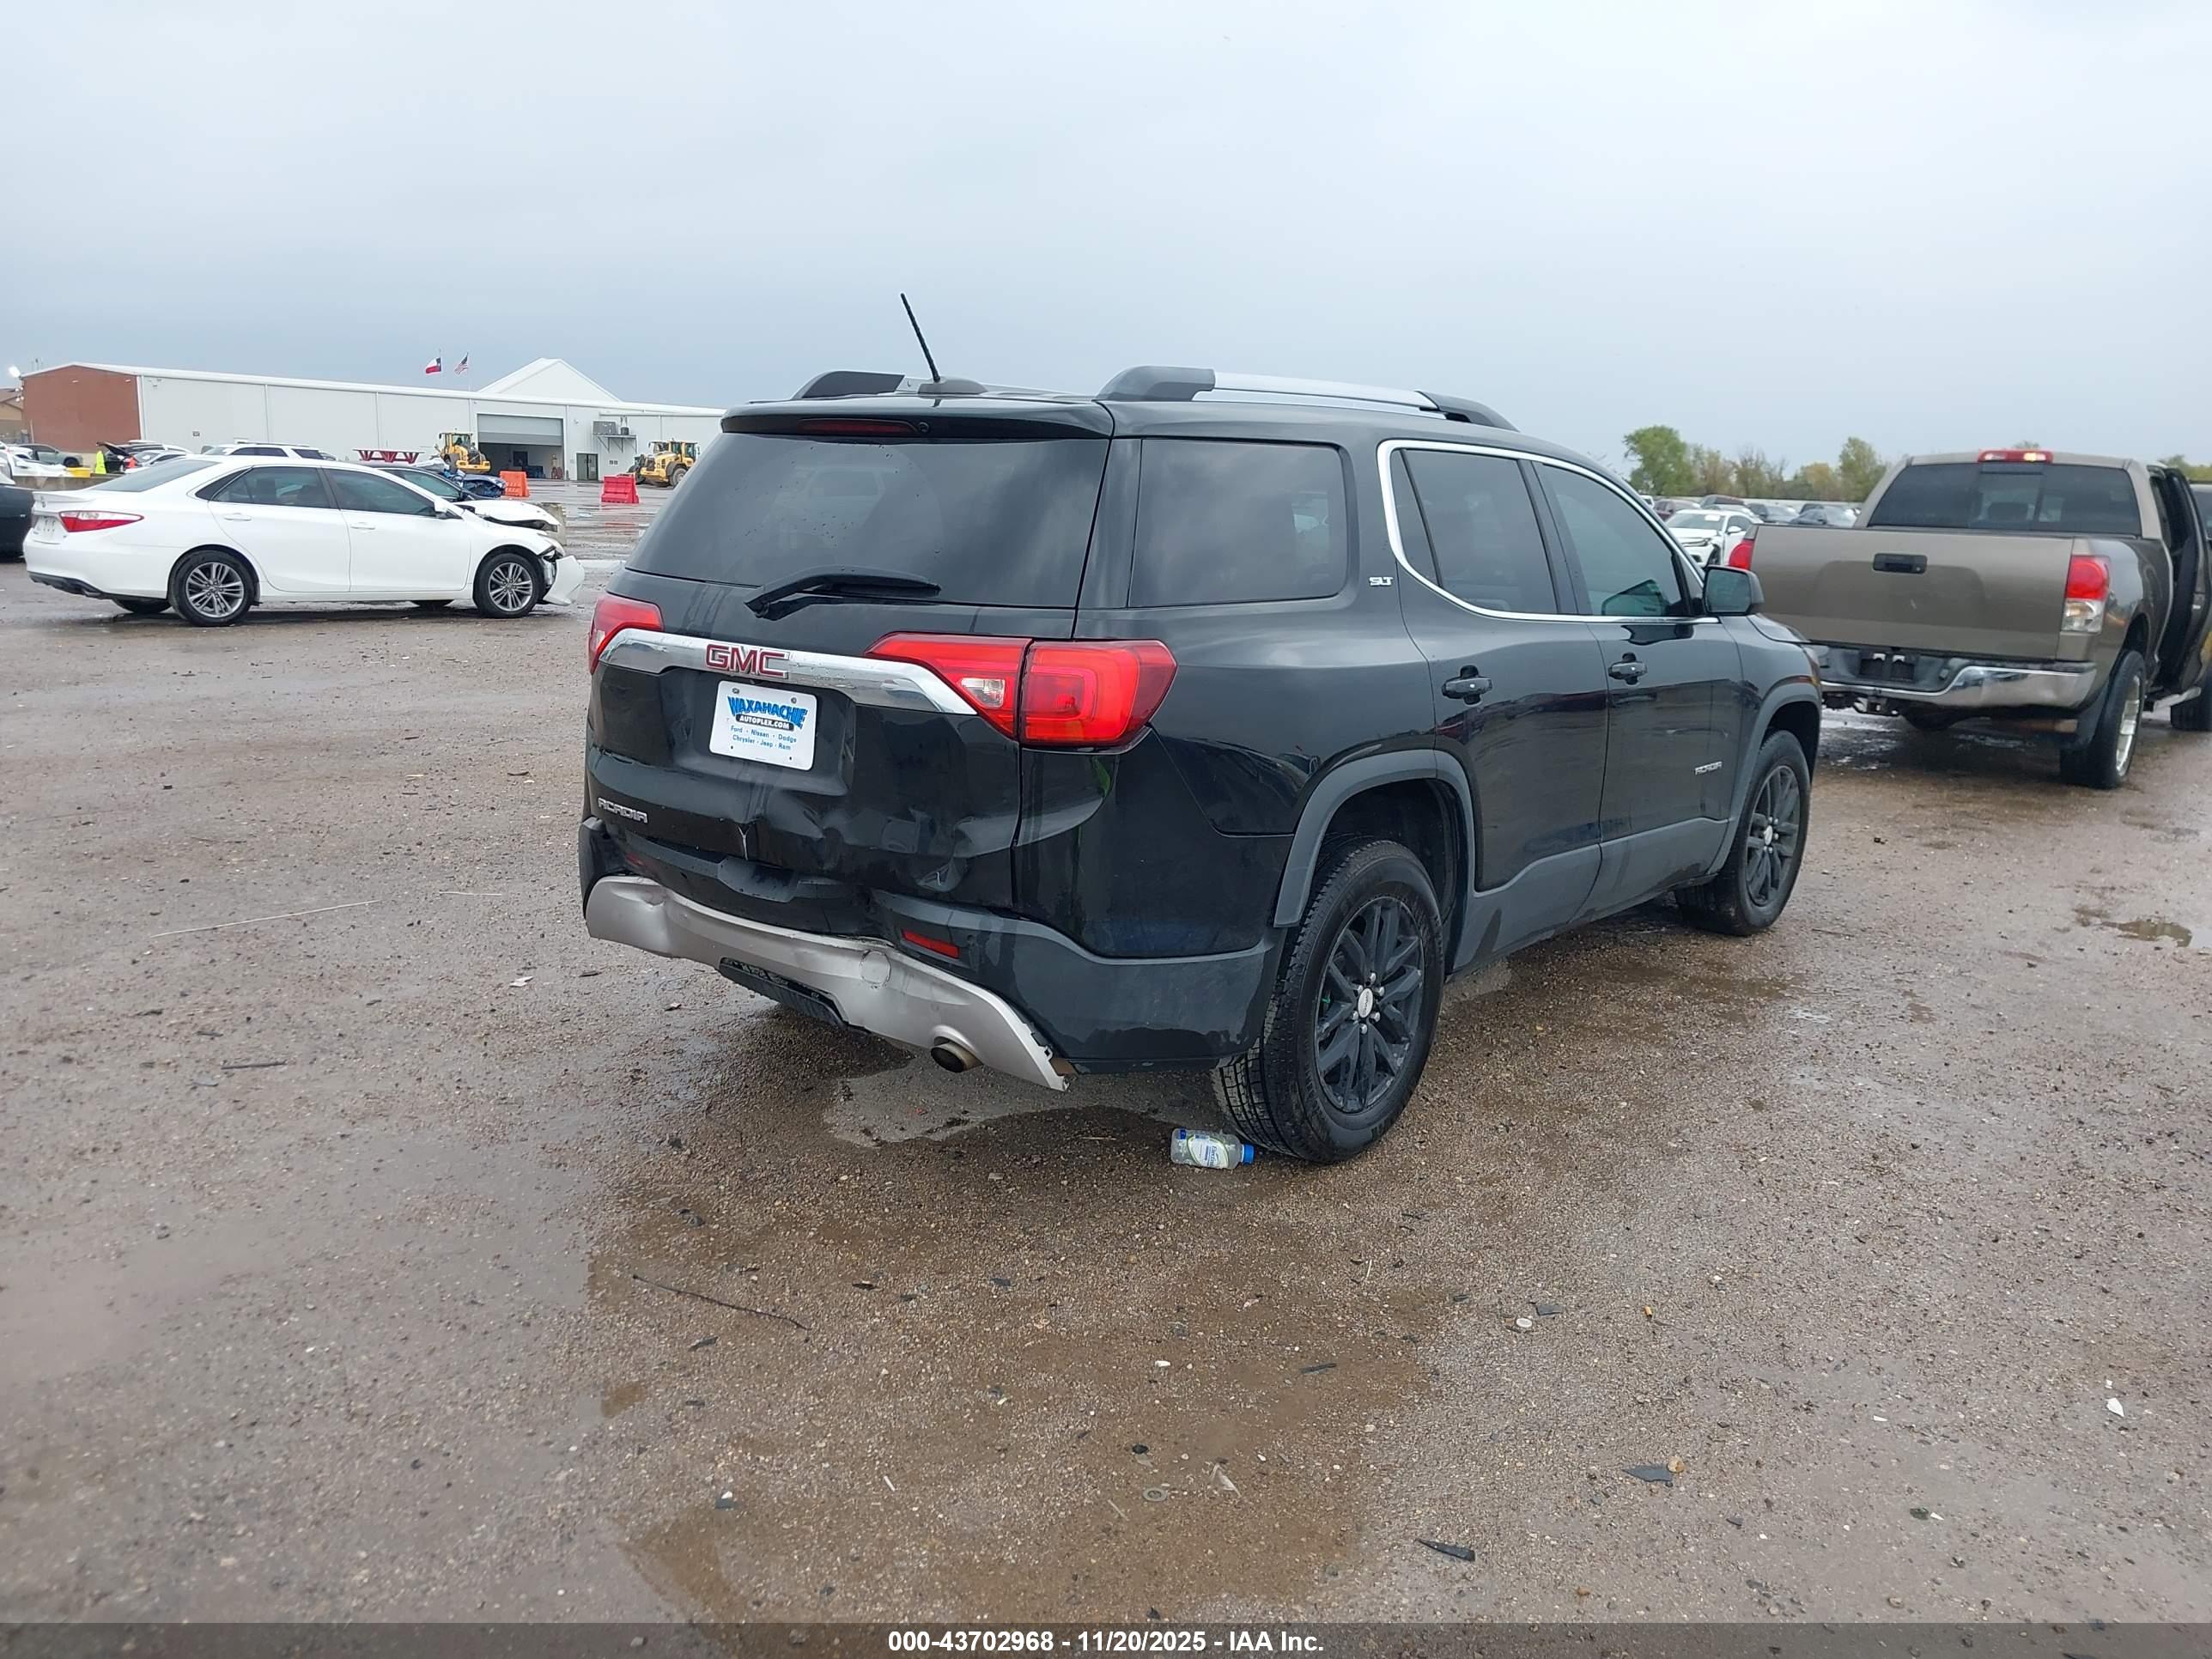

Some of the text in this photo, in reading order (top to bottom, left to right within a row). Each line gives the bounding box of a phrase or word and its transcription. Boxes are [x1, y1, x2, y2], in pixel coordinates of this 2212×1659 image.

[1369, 576, 1394, 586] SLT
[706, 643, 789, 679] GMC
[727, 696, 808, 730] WAXAHACHIE
[738, 714, 790, 731] AUTOPLEX.COM
[730, 725, 797, 744] Ford Nissan Dodge
[732, 734, 791, 750] Chrysler Jeep Ram
[598, 797, 648, 823] ACADIA
